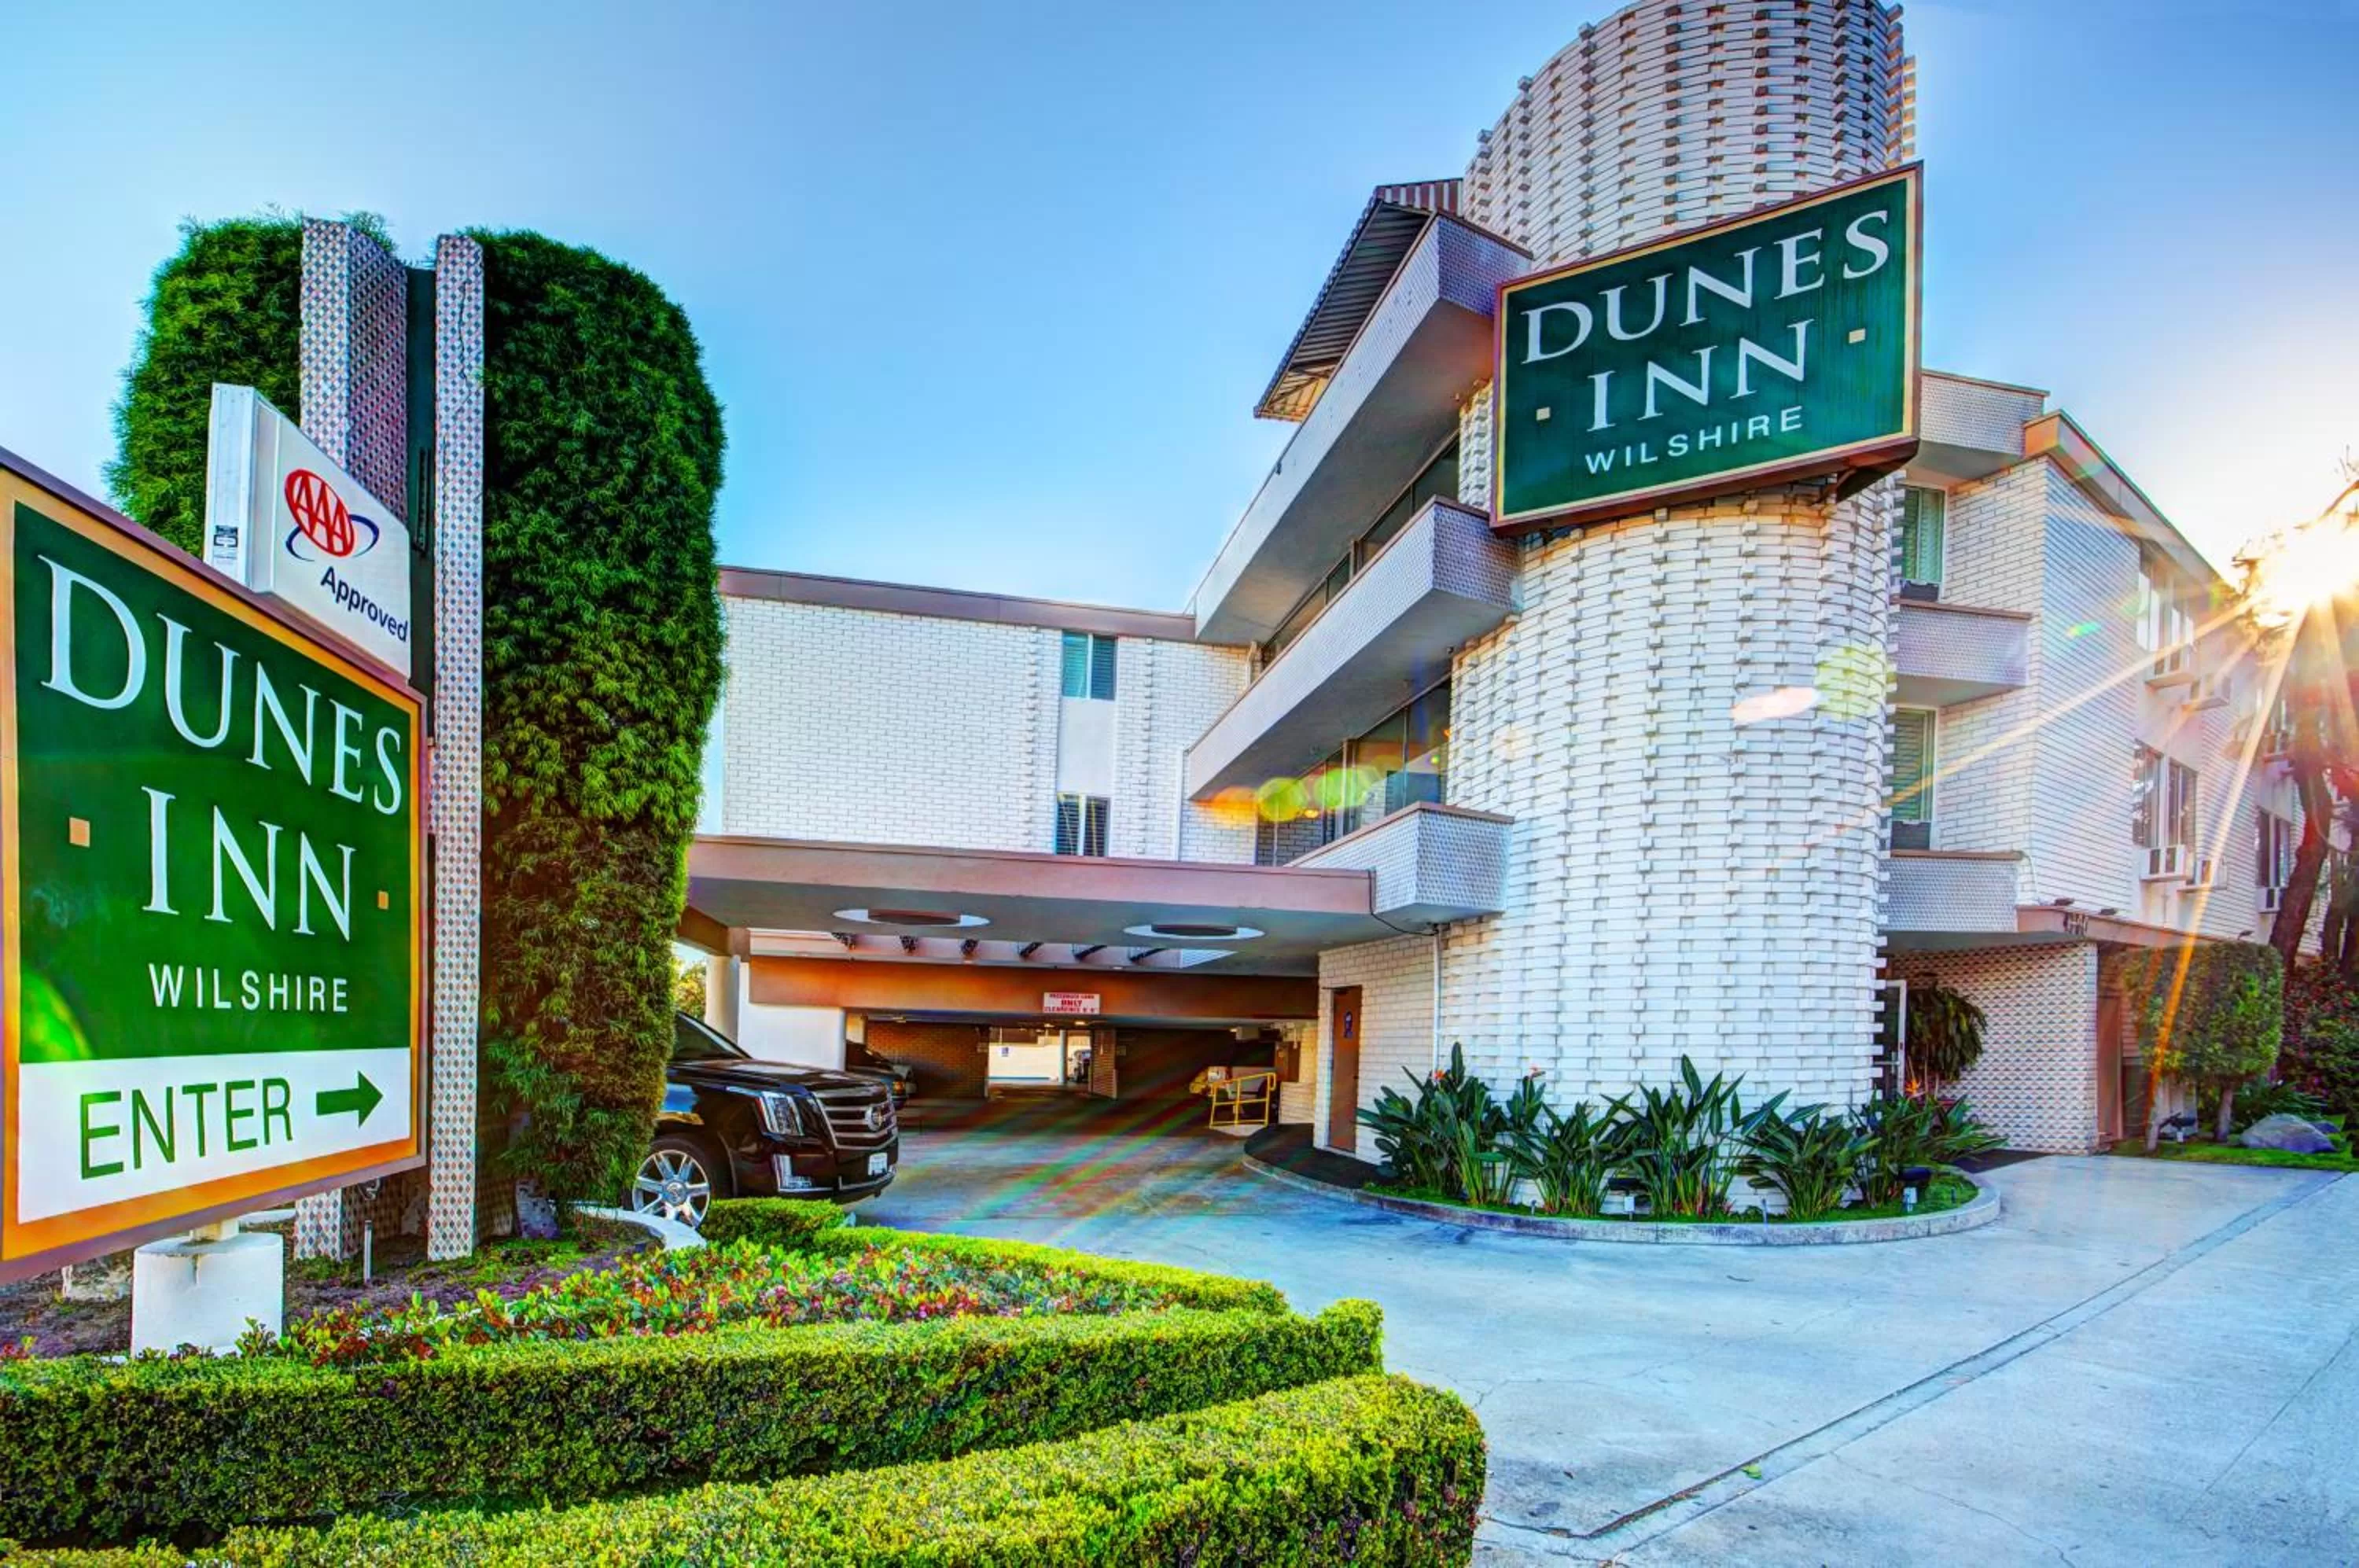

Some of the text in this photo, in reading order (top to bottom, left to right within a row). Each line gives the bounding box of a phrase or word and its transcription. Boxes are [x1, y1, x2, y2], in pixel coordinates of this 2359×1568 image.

[1521, 210, 1889, 364] DUNES
[1587, 318, 1814, 432] INN
[1585, 406, 1803, 473] WILSHIRE
[289, 470, 352, 556] AAA
[320, 566, 408, 642] Approved
[38, 554, 402, 815] DUNES
[142, 786, 356, 942] INN
[149, 963, 348, 1012] WILSHIRE
[81, 1077, 293, 1180] ENTER
